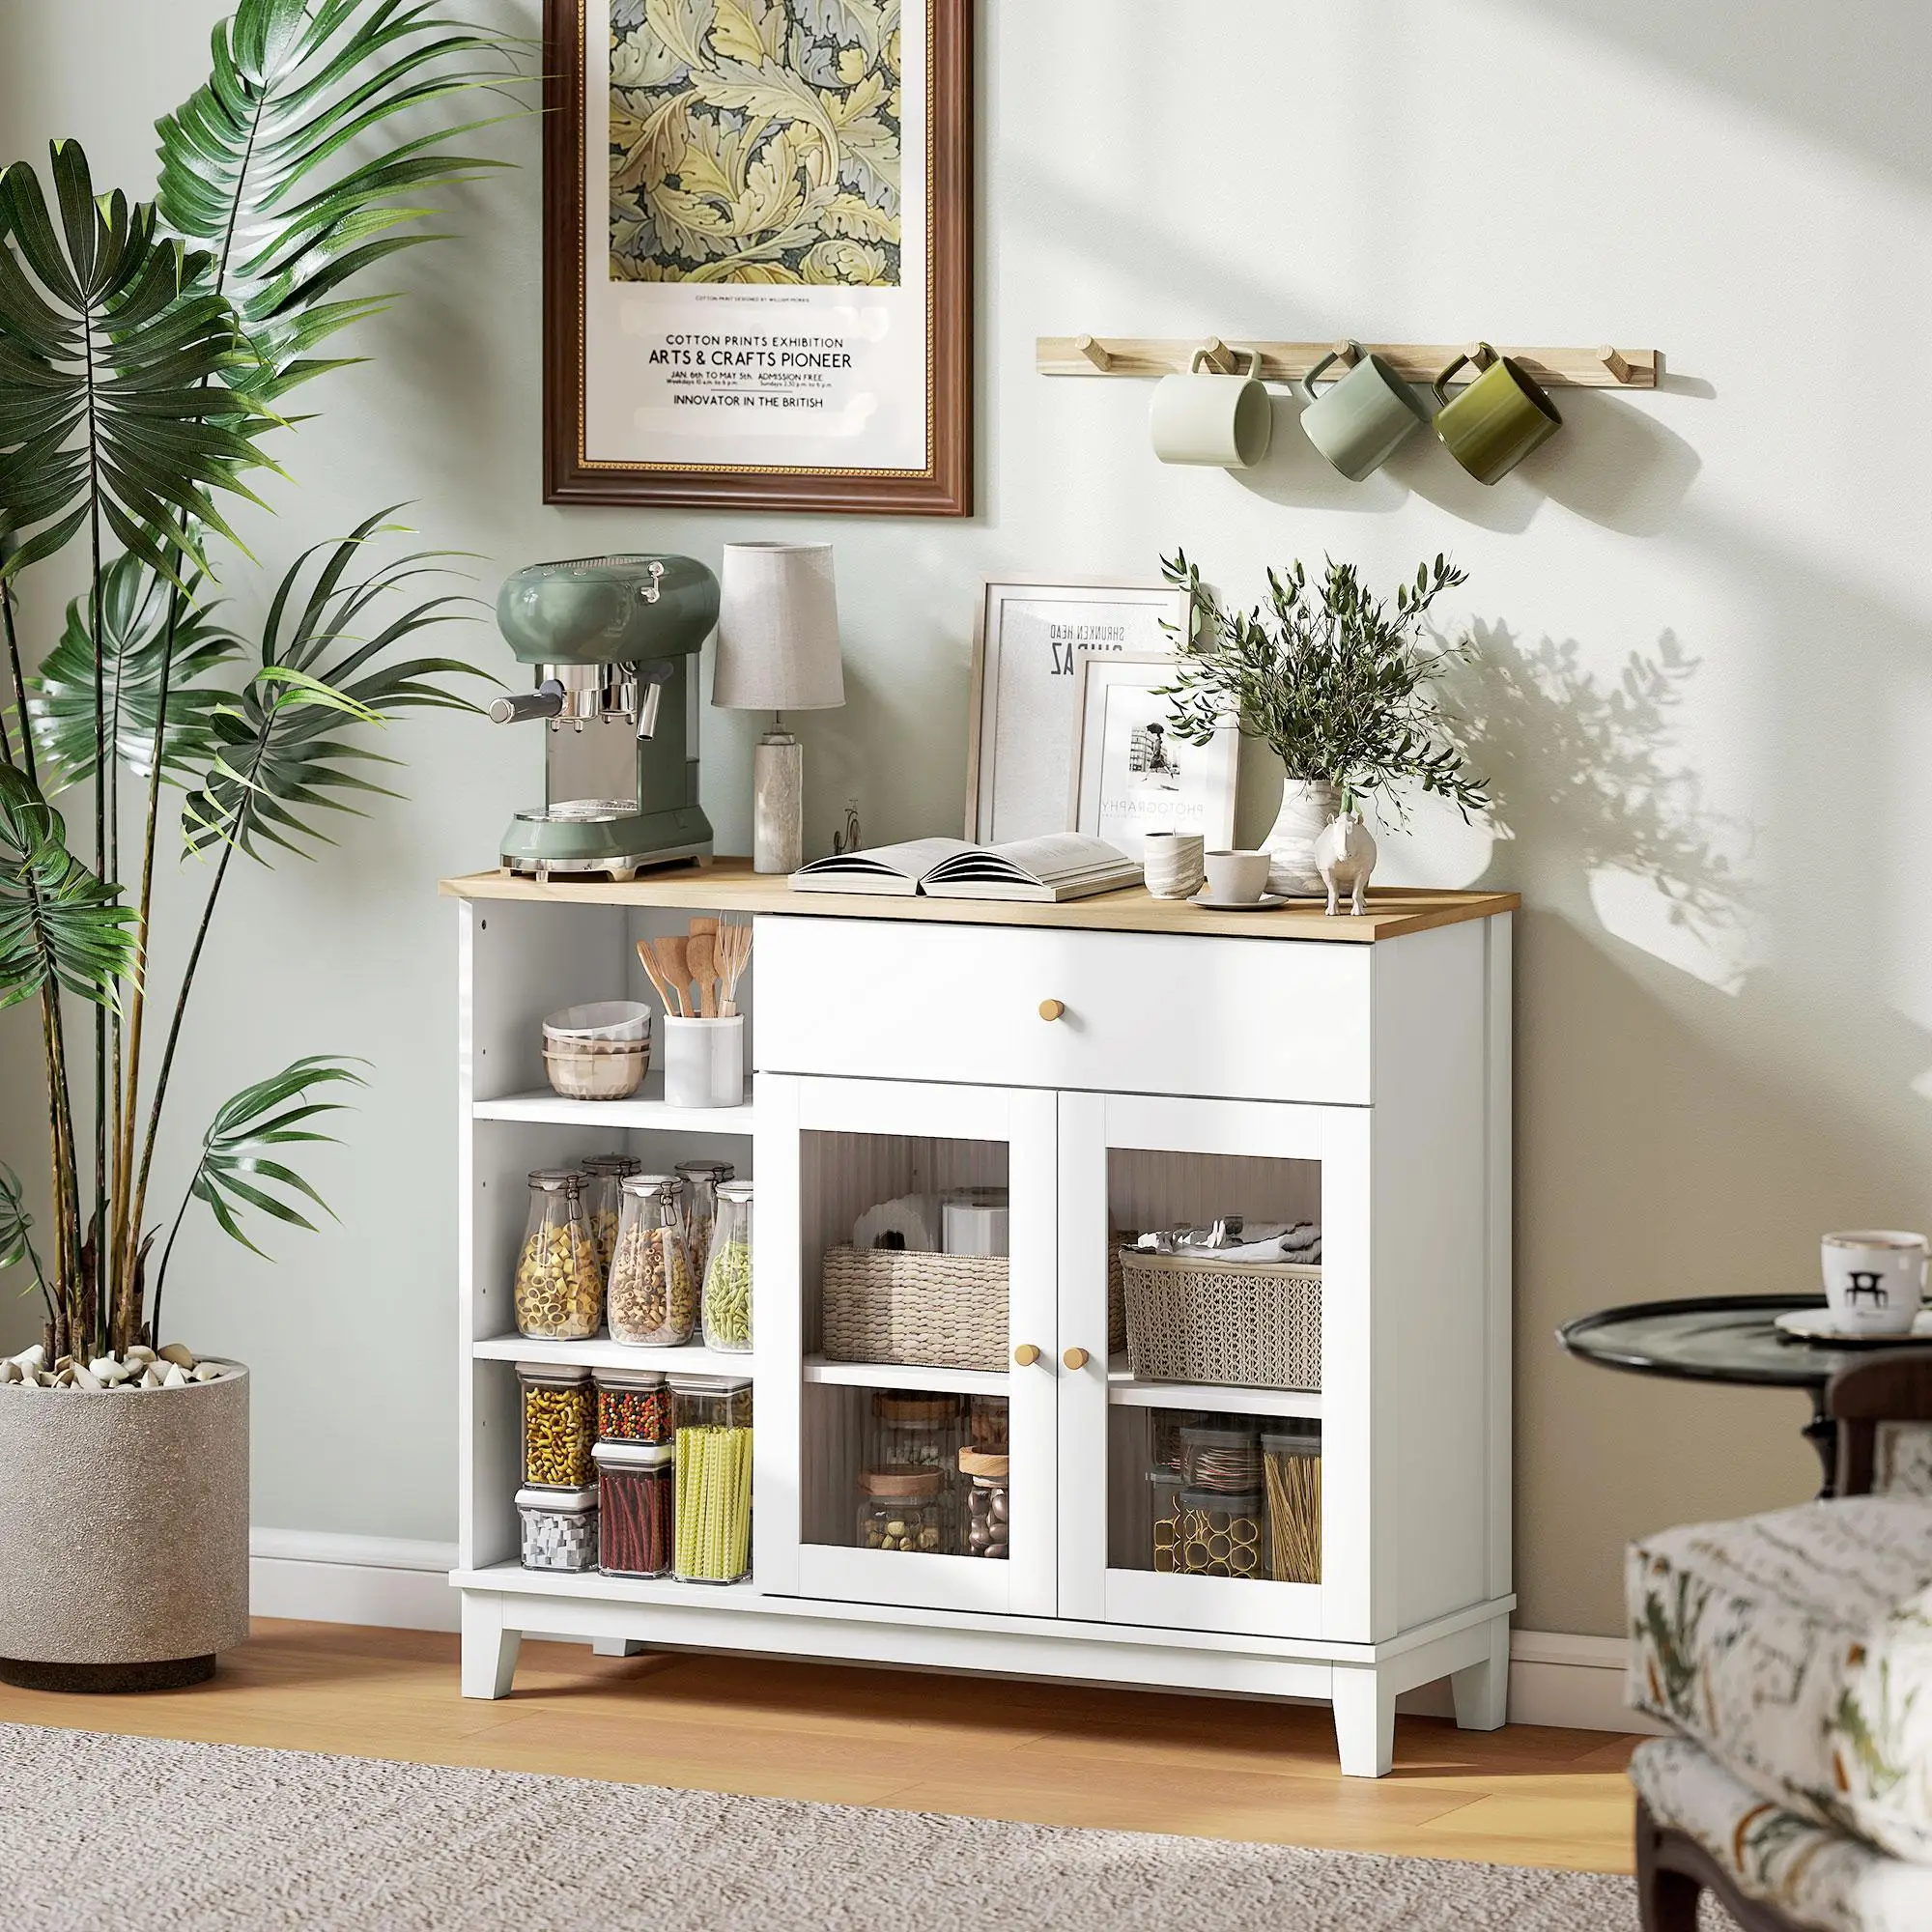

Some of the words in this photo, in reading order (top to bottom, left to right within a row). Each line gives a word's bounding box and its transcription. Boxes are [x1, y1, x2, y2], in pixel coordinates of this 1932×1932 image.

[666, 334, 720, 346] COTTON
[724, 336, 768, 347] PRINTS
[773, 337, 843, 348] EXHIBITION
[649, 350, 692, 365] ARTS
[696, 351, 706, 365] &
[711, 351, 776, 366] CRAFTS
[781, 353, 852, 368] PIONEER
[673, 395, 740, 407] INNOVATOR
[744, 396, 753, 407] IN
[758, 397, 780, 408] THE
[782, 397, 823, 408] BRITISH
